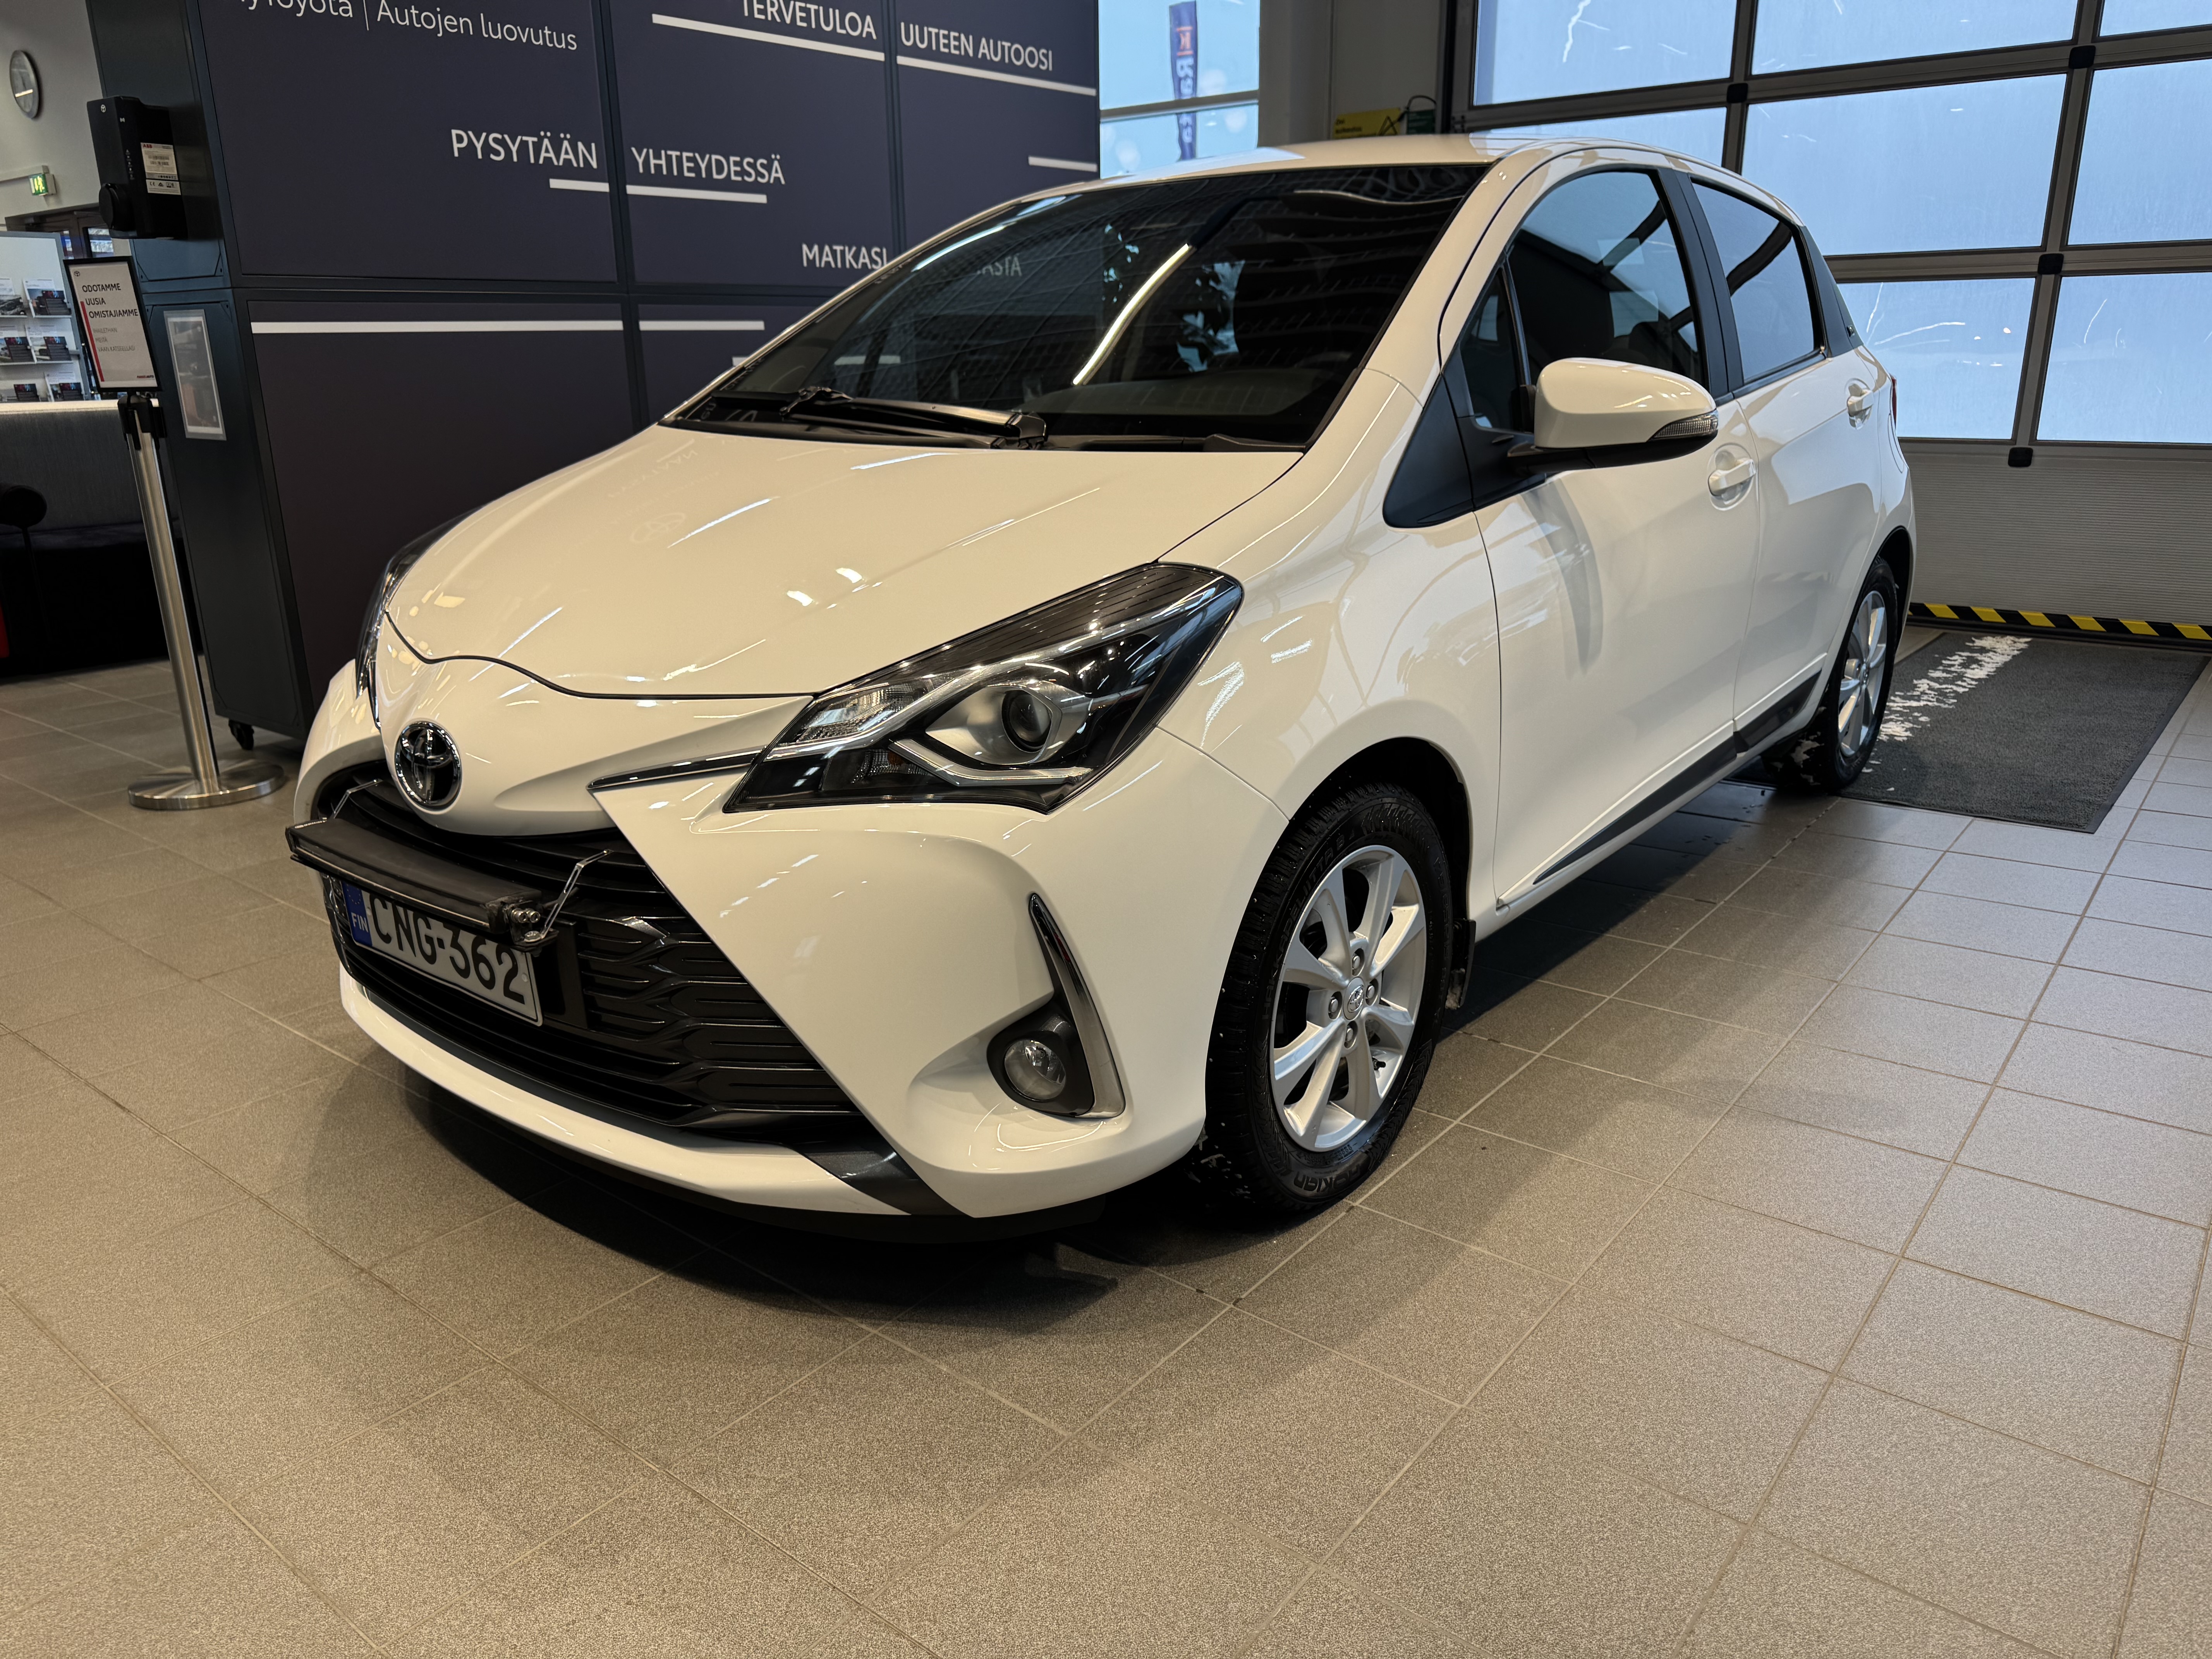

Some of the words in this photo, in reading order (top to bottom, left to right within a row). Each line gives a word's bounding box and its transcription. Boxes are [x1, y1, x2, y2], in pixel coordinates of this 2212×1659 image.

[377, 0, 473, 37] Autojen
[481, 13, 577, 51] luovutus
[743, 0, 877, 40] TERVETULOA
[900, 22, 973, 58] UUTEEN
[978, 36, 1053, 71] AUTOOSI
[451, 129, 597, 169] PYSYTÄÄN
[631, 147, 786, 185] YHTEYDESSÄ
[802, 243, 888, 270] MATKASI
[82, 283, 121, 292] ODOTAMME
[85, 297, 106, 306] UUSIA
[89, 309, 139, 318] OMISTAJIAMME
[350, 912, 369, 933] FIN
[369, 893, 525, 1005] CNG-362
